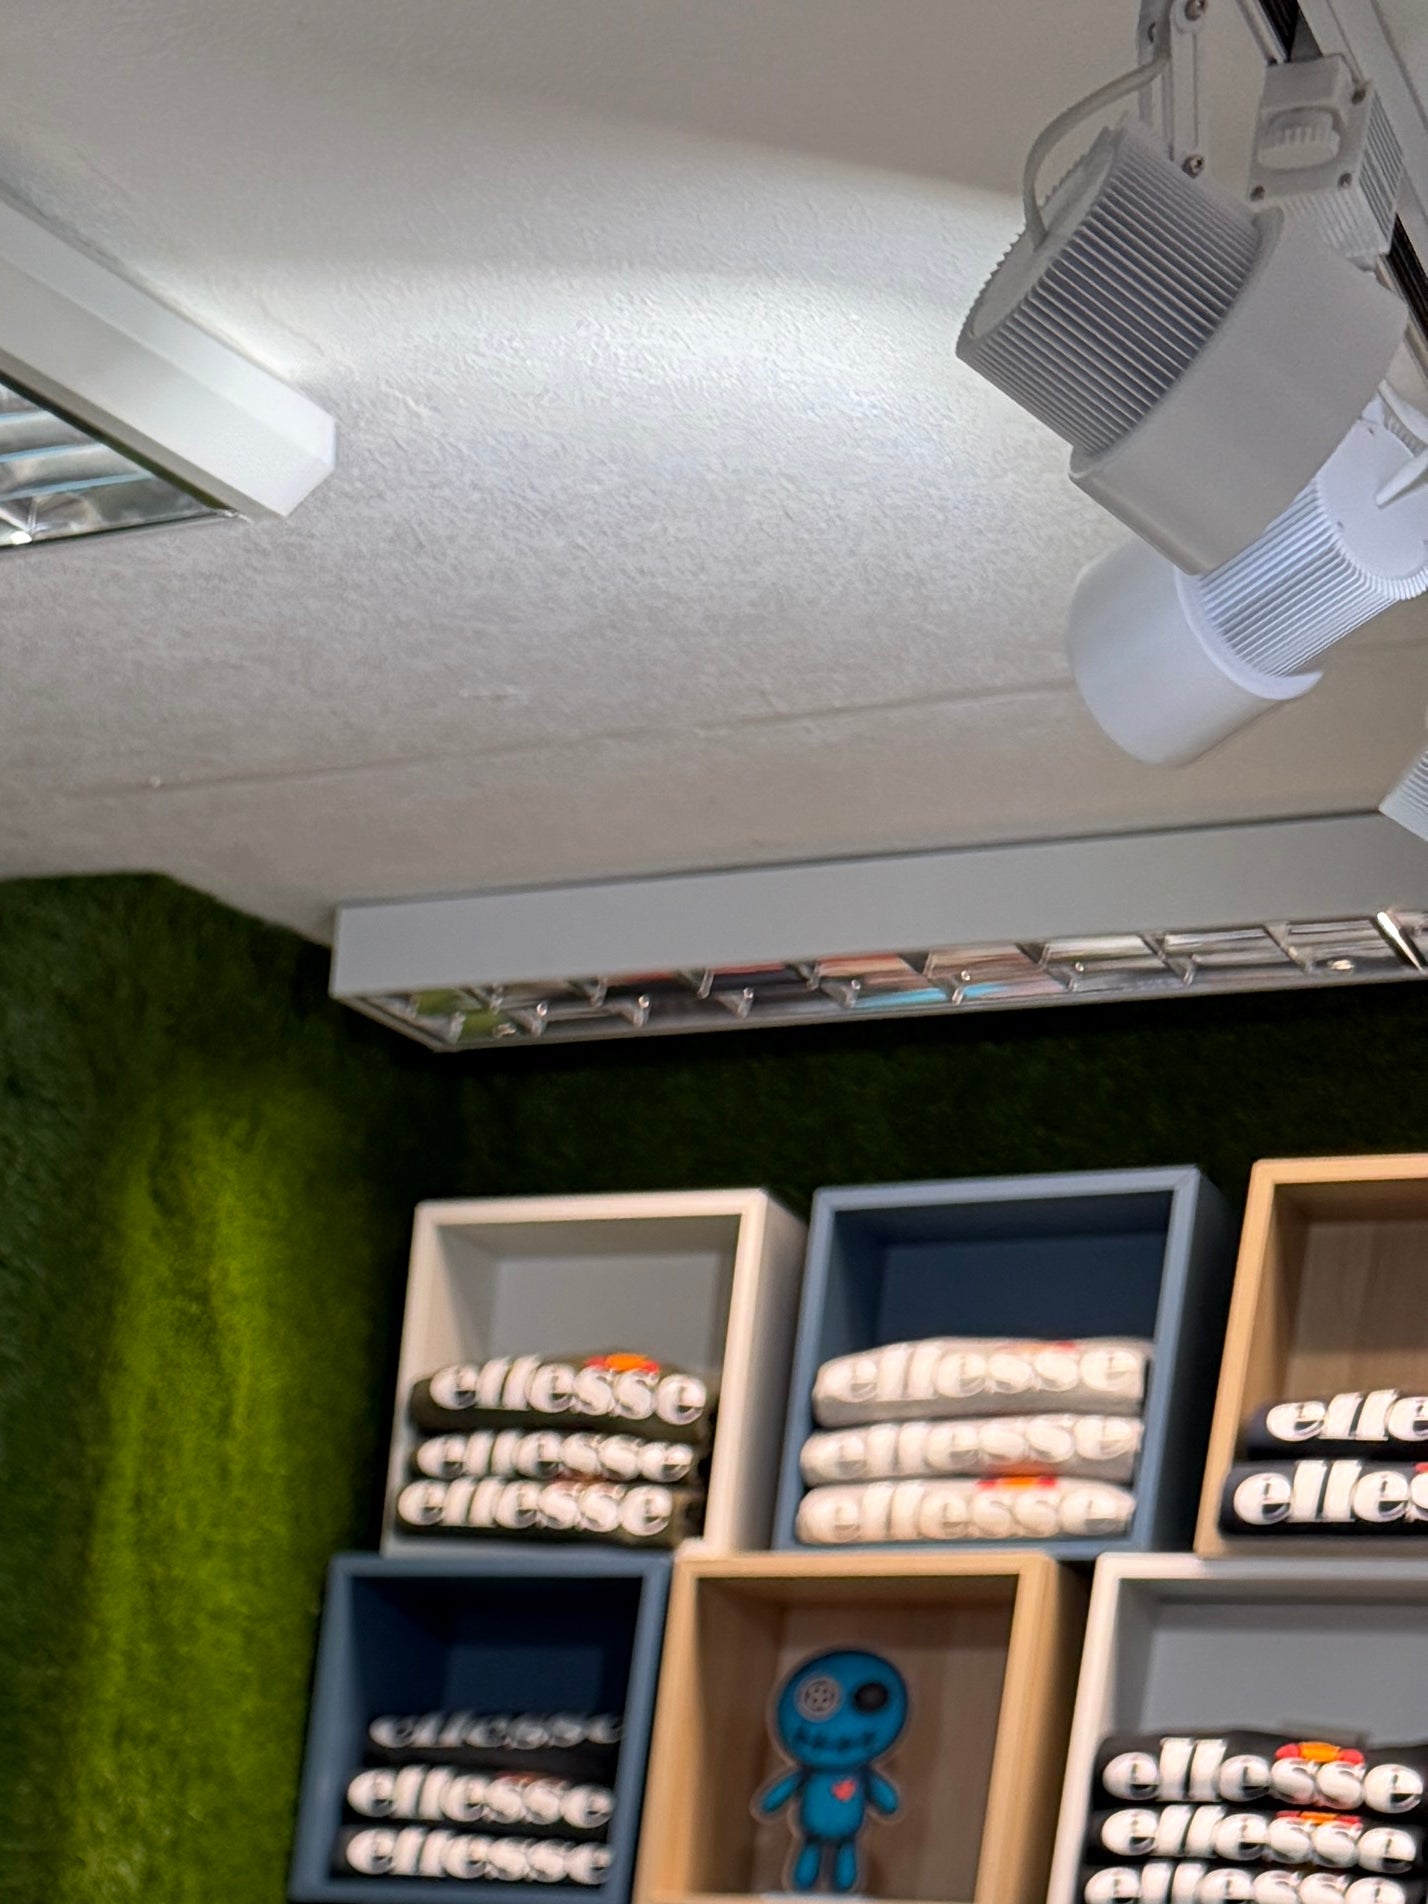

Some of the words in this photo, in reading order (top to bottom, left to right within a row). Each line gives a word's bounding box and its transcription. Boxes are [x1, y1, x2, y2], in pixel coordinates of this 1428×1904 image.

[430, 1354, 707, 1425] ellesse
[816, 1344, 1139, 1402] ellesse
[417, 1429, 694, 1483] ellesse
[801, 1415, 1134, 1478] ellesse
[398, 1476, 673, 1536] ellesse
[799, 1480, 1124, 1544] ellesse
[347, 1764, 615, 1829] ellesse
[1102, 1737, 1424, 1814] ellesse
[346, 1826, 614, 1885] ellesse
[1101, 1804, 1416, 1874] ellesse
